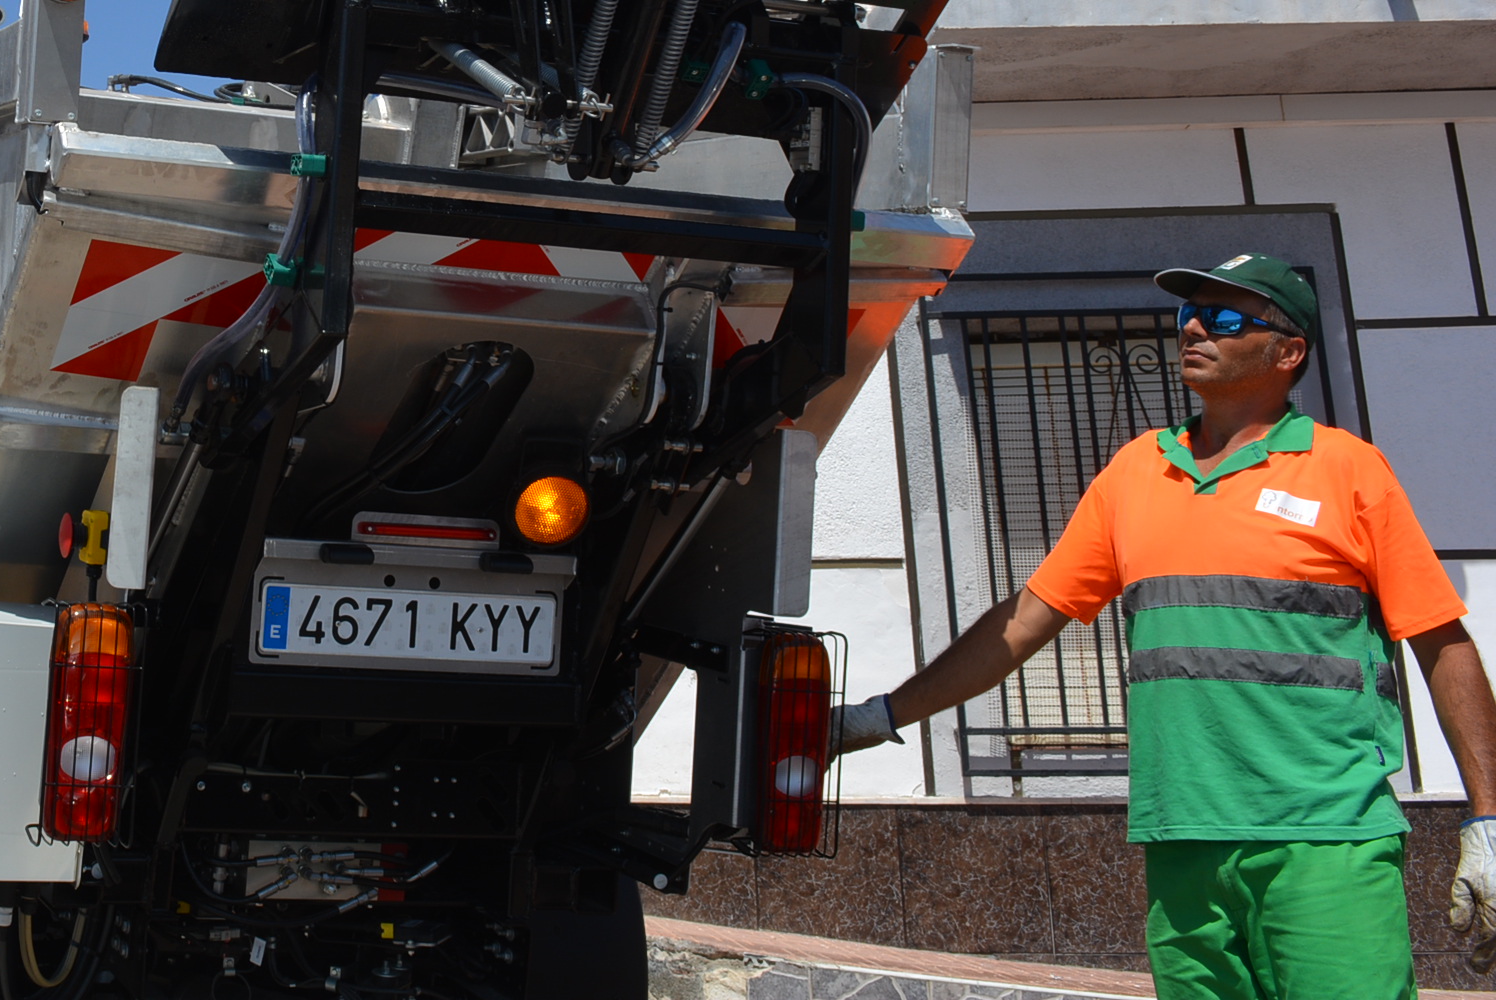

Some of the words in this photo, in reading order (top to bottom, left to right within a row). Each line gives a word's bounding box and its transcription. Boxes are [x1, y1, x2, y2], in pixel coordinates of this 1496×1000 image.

[270, 624, 281, 639] E
[298, 595, 420, 649] 4671
[449, 602, 541, 654] KYY
